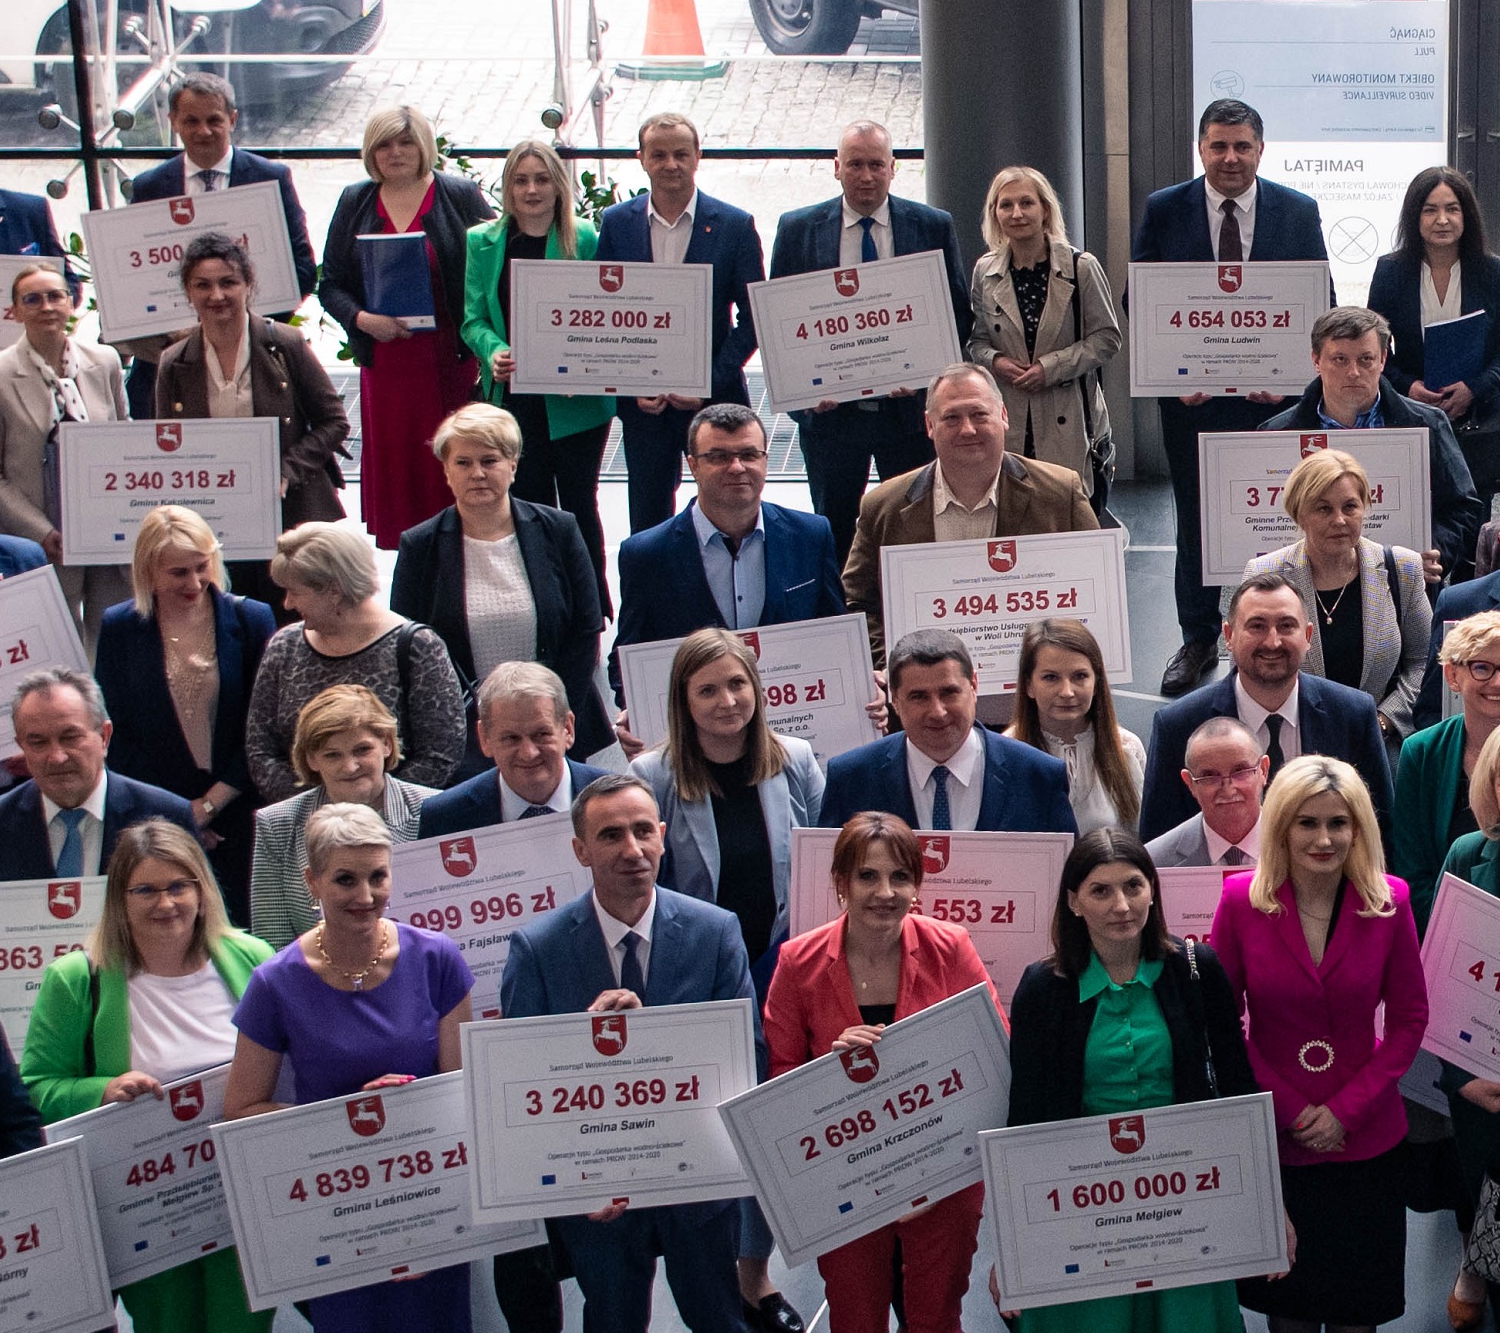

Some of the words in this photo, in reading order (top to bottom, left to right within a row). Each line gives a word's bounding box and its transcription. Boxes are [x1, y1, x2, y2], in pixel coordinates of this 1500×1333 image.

[551, 309, 562, 326] 3
[568, 309, 604, 326] 282
[611, 310, 647, 328] 000
[653, 311, 670, 328] zł
[1169, 310, 1182, 327] 4
[1188, 310, 1224, 327] 654
[1230, 310, 1266, 327] 053
[1272, 310, 1290, 327] zł
[565, 333, 593, 343] Gmina
[1202, 335, 1230, 344] Gmina
[1230, 335, 1261, 344] Ludwin
[6, 639, 29, 664] zł
[1468, 960, 1484, 981] 4
[526, 1090, 542, 1115] 3
[552, 1084, 604, 1113] 240
[614, 1078, 666, 1107] 369
[675, 1075, 699, 1101] zł
[799, 1136, 820, 1160] 2
[824, 1109, 876, 1147] 698
[882, 1083, 933, 1120] 152
[937, 1068, 963, 1097] zł
[578, 1121, 618, 1135] Gmina
[619, 1117, 655, 1131] Sawin
[845, 1142, 883, 1164] Gmina
[883, 1114, 943, 1147] Krzczonów
[1046, 1188, 1059, 1211] 1
[1072, 1180, 1124, 1208] 600
[1134, 1171, 1186, 1199] 000
[1195, 1166, 1220, 1191] zł
[1093, 1214, 1133, 1228] Gmina
[14, 1224, 39, 1253] zł
